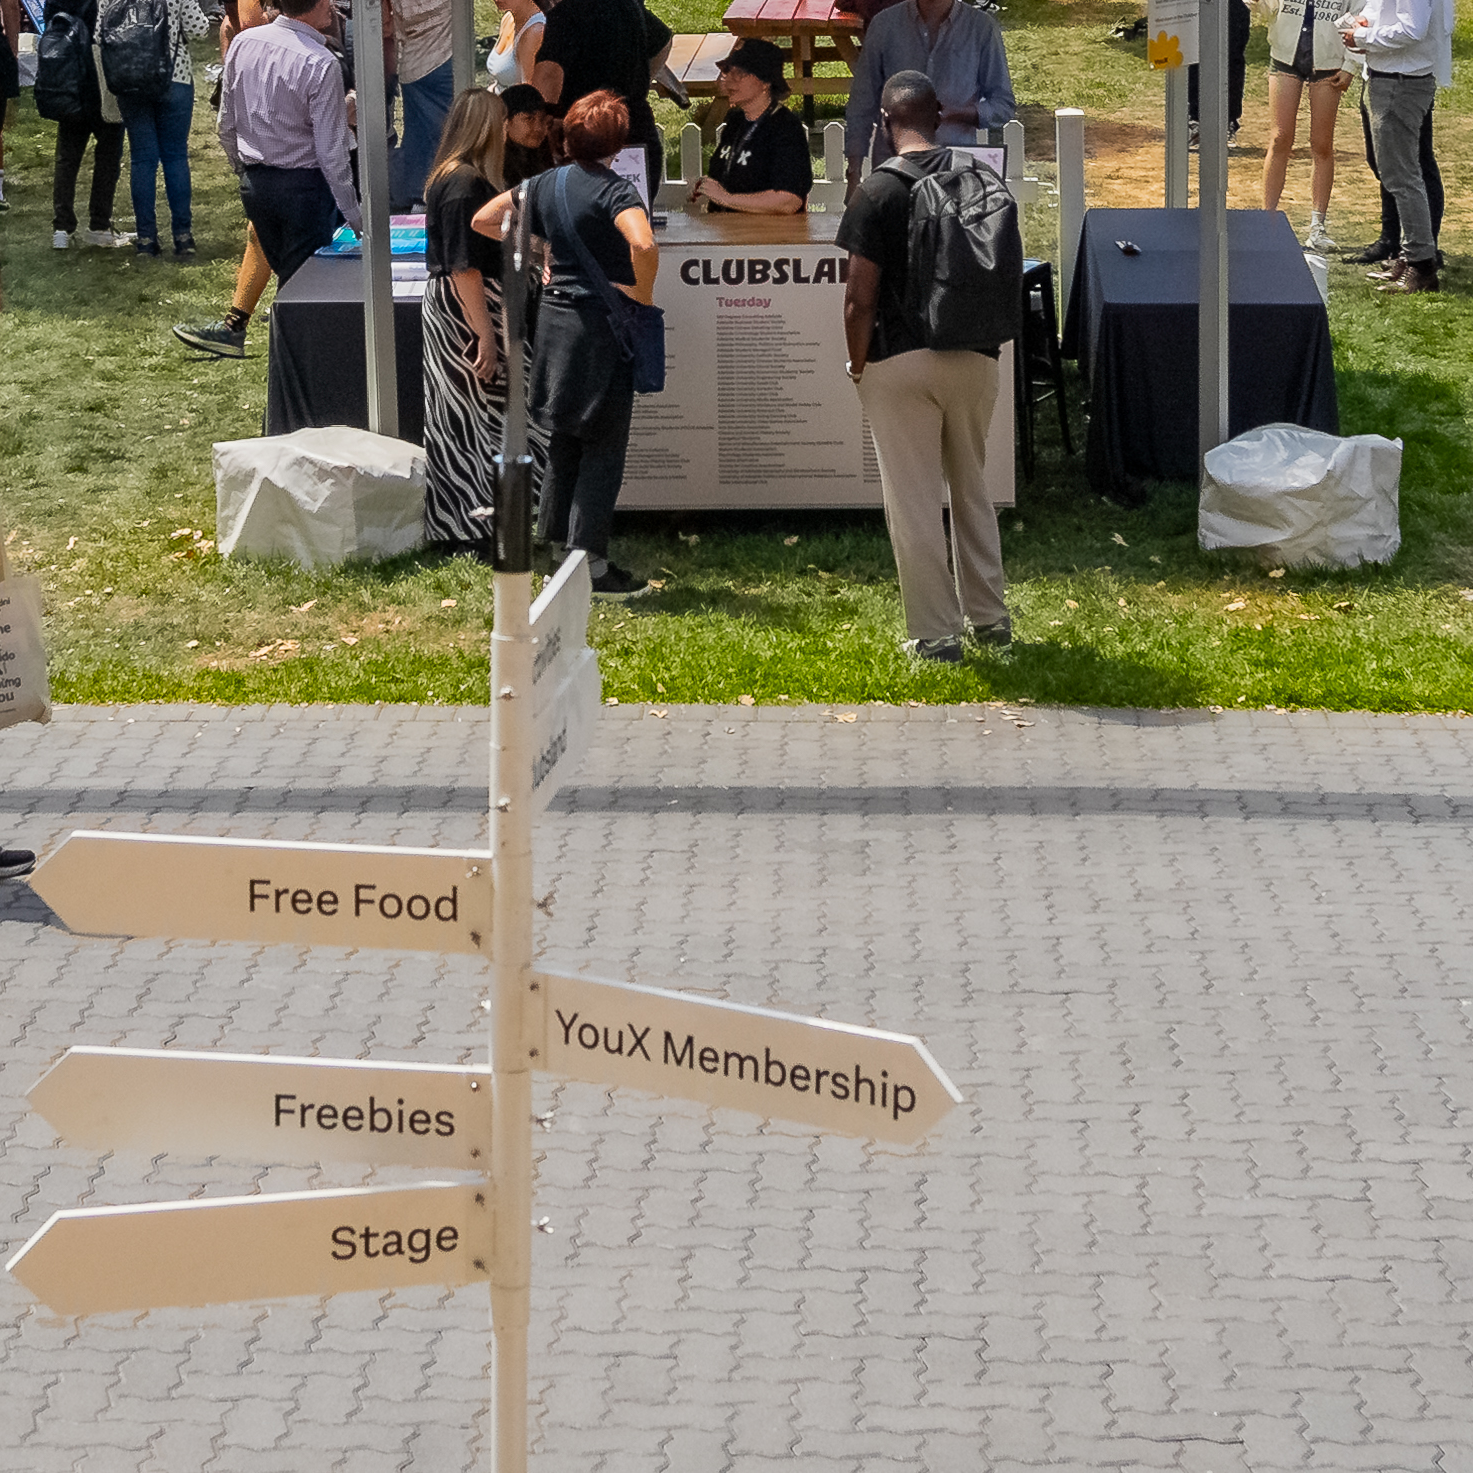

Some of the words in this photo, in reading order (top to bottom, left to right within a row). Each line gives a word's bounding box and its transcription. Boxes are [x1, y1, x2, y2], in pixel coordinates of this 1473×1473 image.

[680, 258, 849, 286] CLUBSLA
[716, 296, 771, 309] Tuesday
[247, 879, 340, 916] Free
[353, 884, 459, 922] Food
[555, 1008, 652, 1062] YouX
[662, 1030, 917, 1121] Membership
[273, 1094, 456, 1138] Freebies
[330, 1224, 459, 1263] Stage
